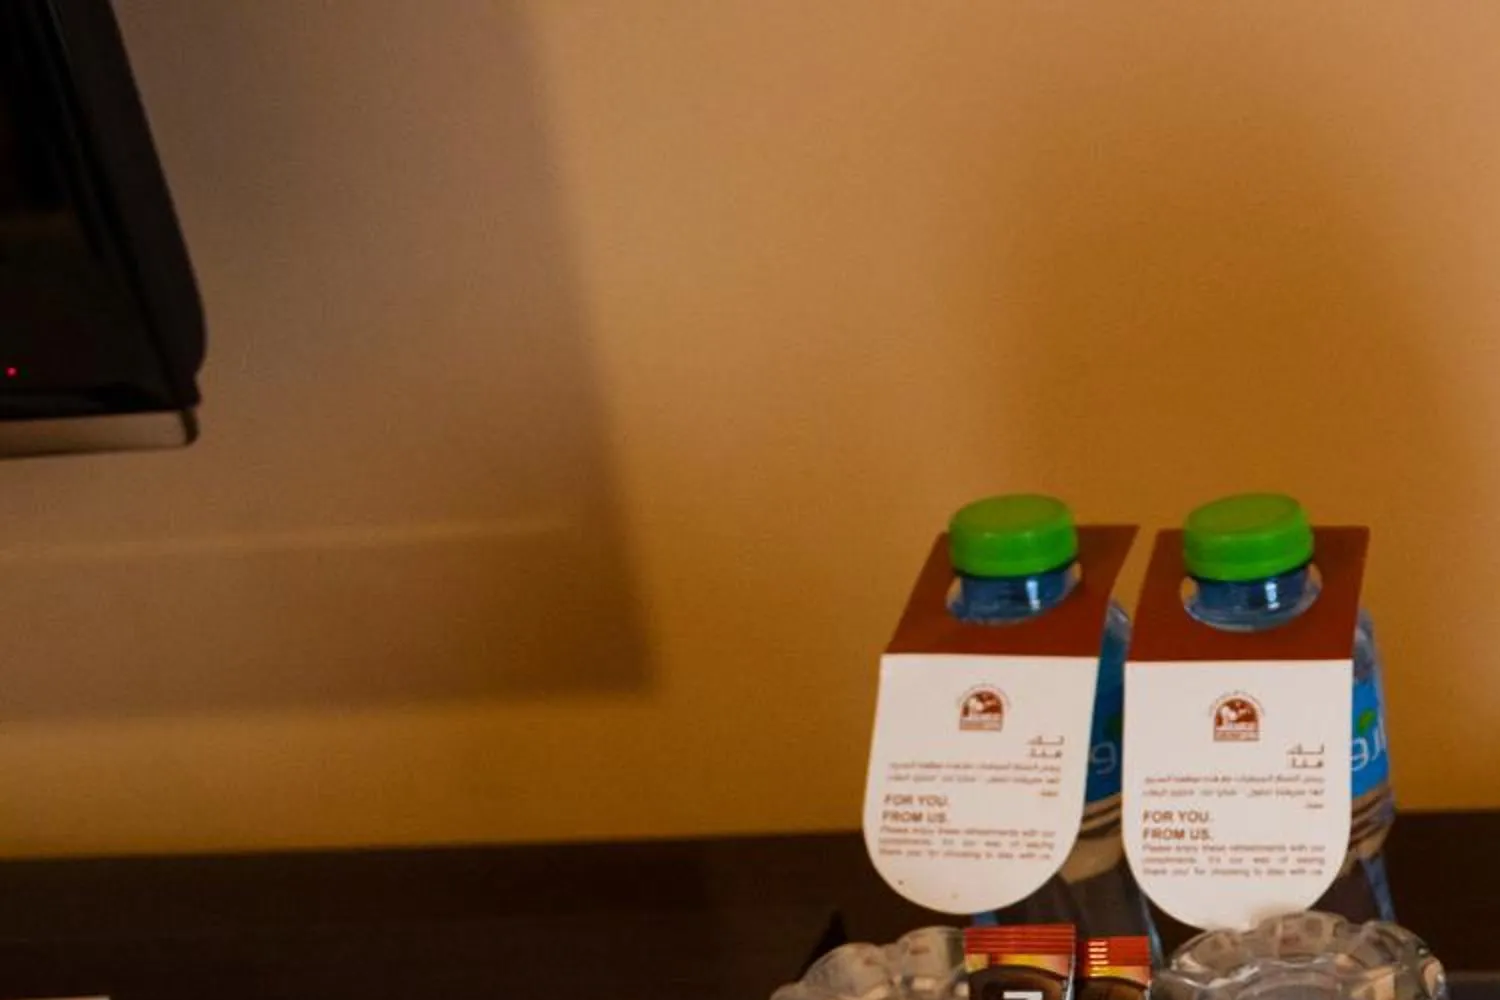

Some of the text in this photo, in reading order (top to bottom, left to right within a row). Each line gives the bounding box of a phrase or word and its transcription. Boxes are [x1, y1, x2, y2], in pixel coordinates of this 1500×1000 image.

[883, 793, 914, 806] FOR
[882, 810, 923, 823] FROM
[1142, 809, 1173, 823] FOR
[1142, 827, 1185, 841] FROM
